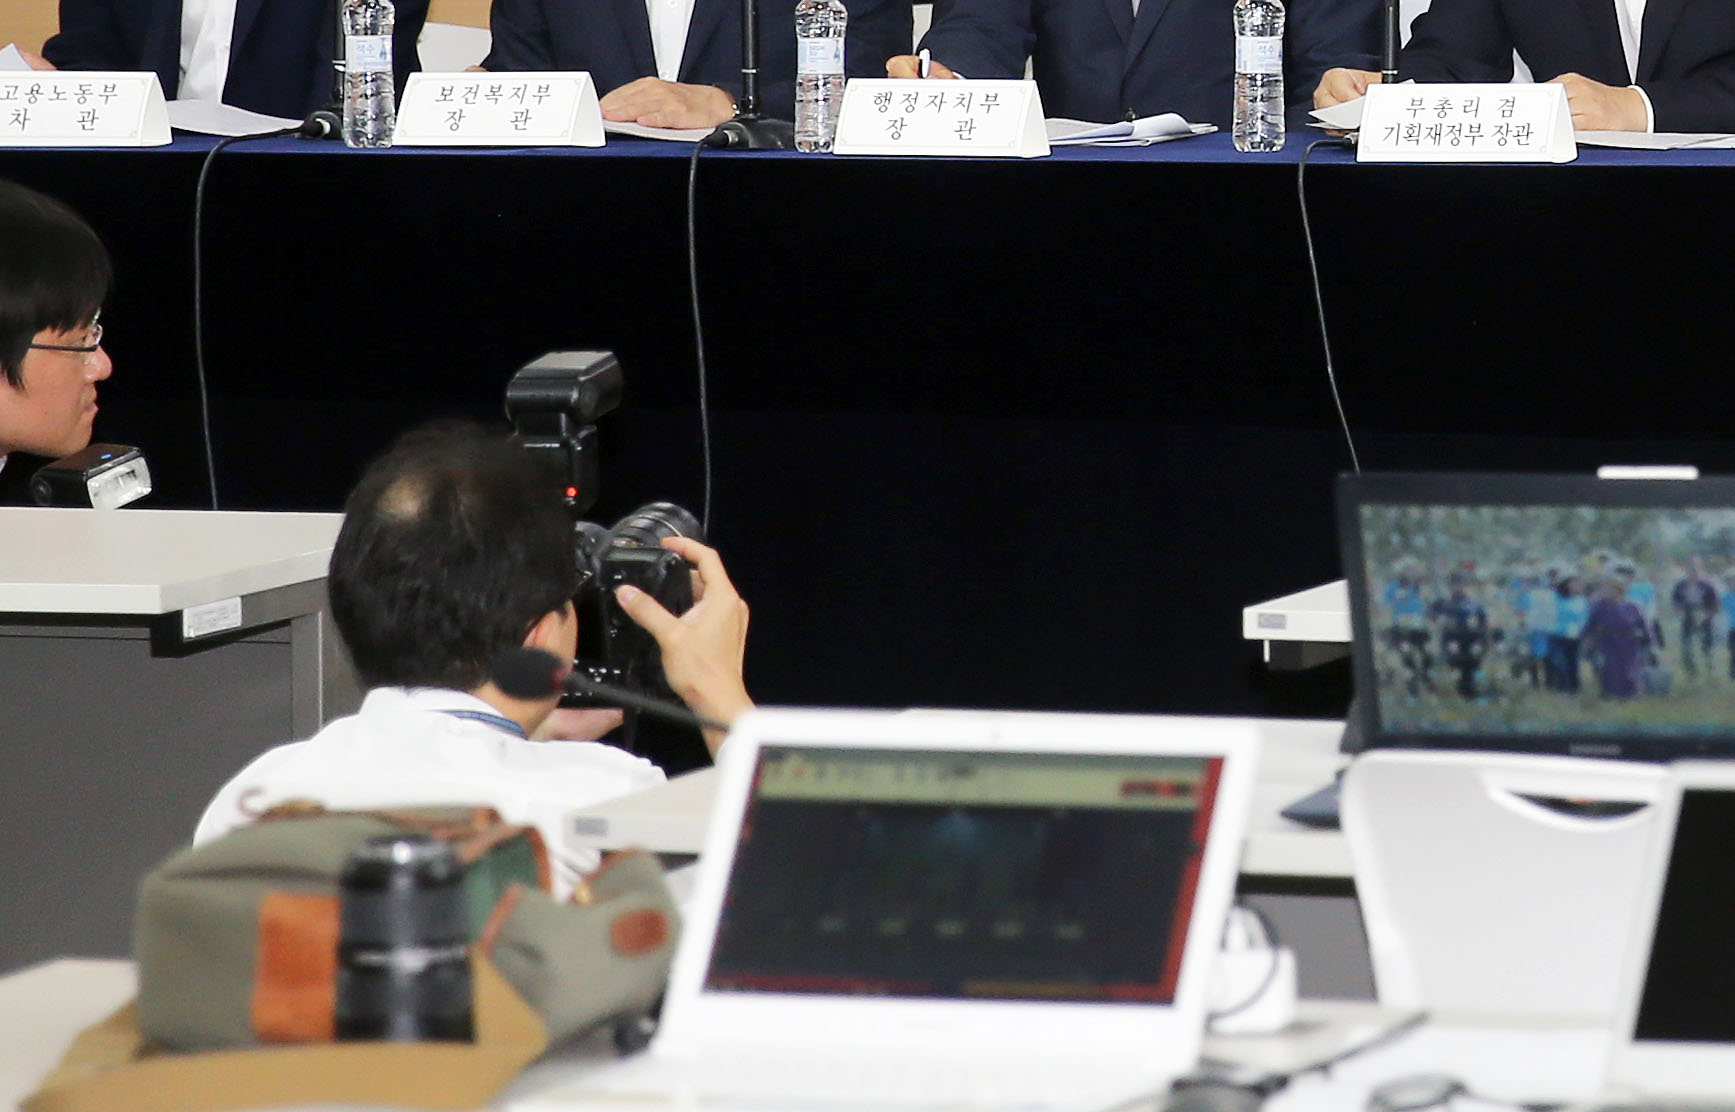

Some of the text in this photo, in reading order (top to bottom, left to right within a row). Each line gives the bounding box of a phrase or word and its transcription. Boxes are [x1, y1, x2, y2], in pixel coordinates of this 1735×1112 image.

[0, 82, 118, 105] 고용노동부
[434, 83, 551, 105] 보건복지부
[873, 90, 1001, 115] 행정자치부
[1405, 96, 1517, 119] 부총리 겸
[1382, 122, 1535, 147] 기획재정부 장관
